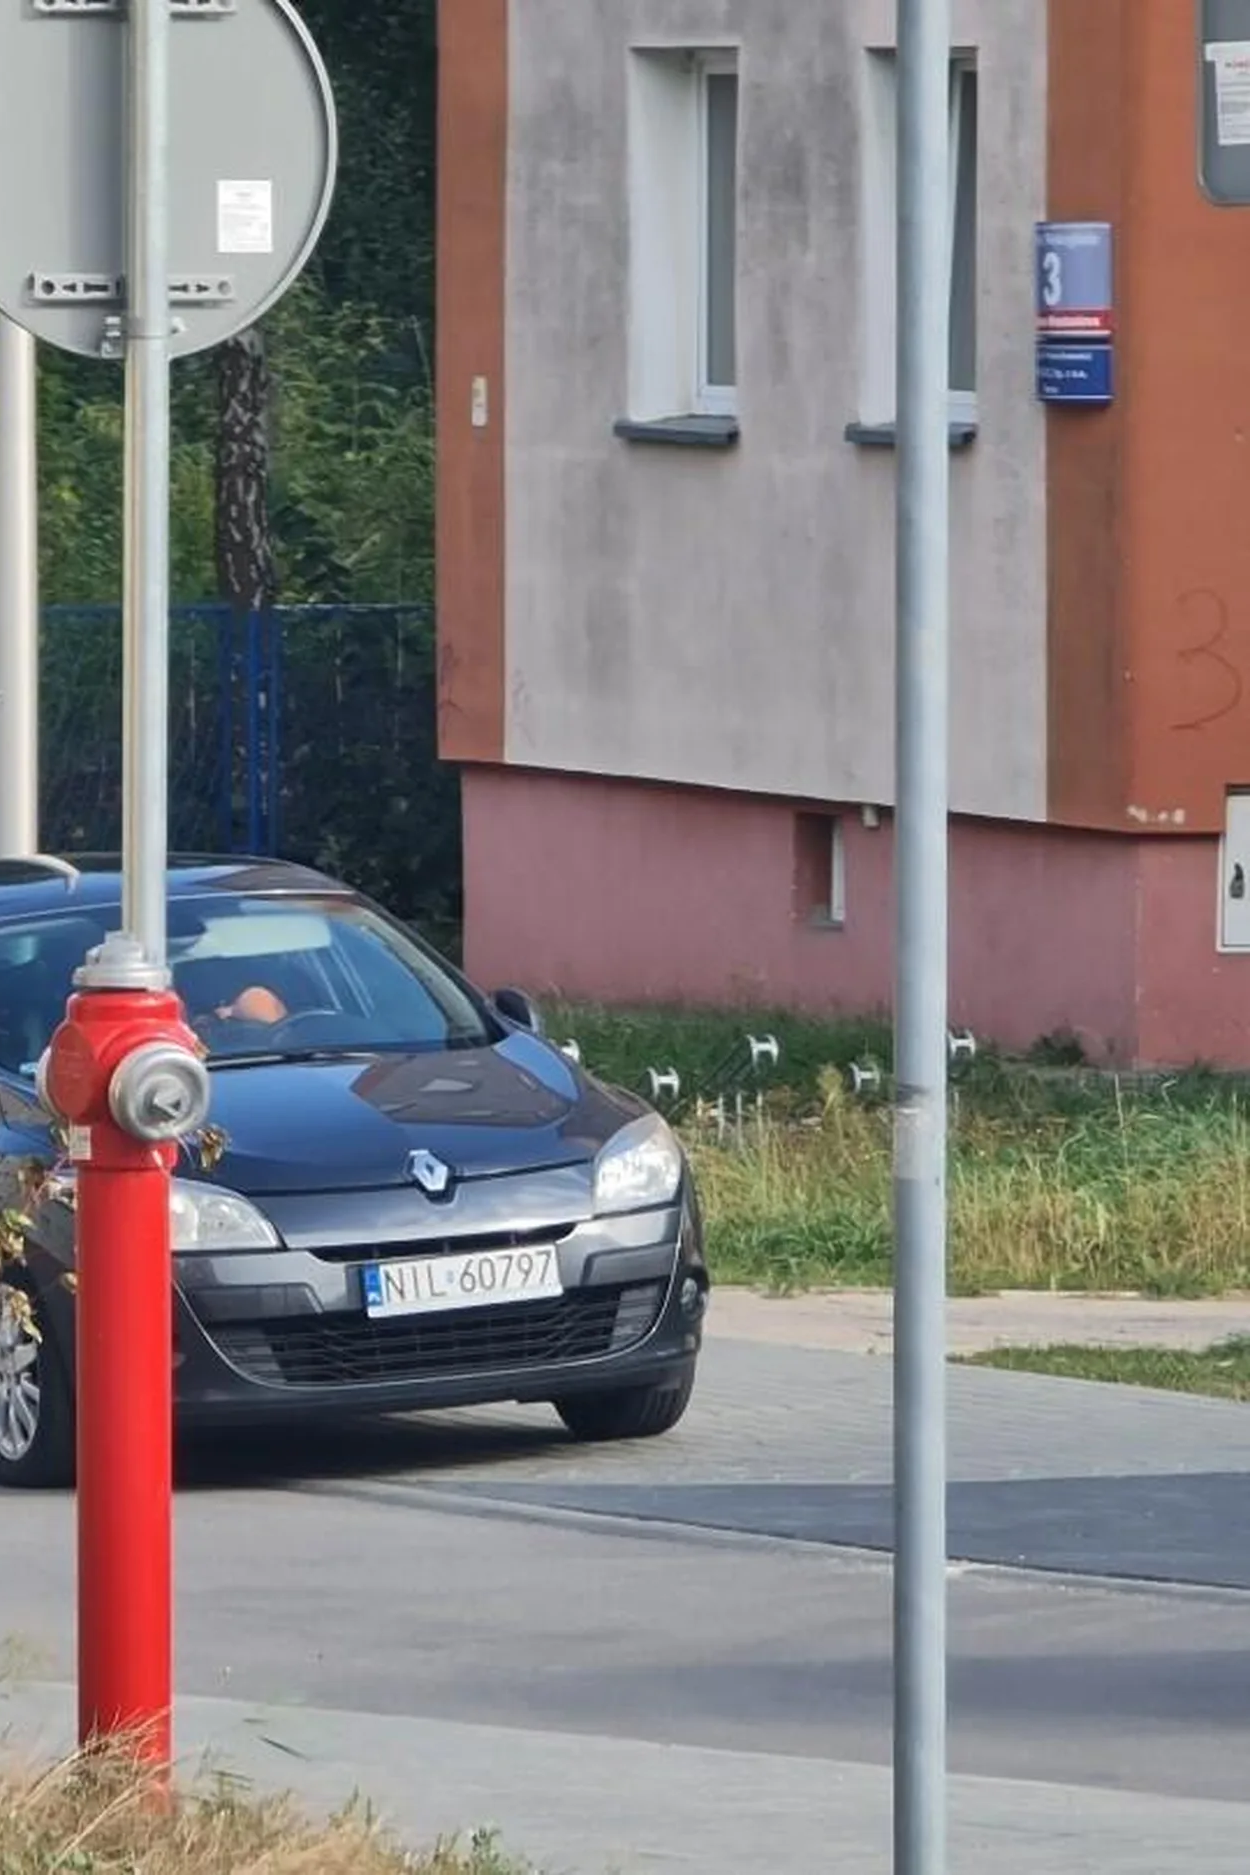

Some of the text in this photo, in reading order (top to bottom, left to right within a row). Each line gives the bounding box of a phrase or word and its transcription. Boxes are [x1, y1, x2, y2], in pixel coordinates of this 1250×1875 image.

[1043, 251, 1062, 306] 3
[384, 1249, 553, 1301] NIL 60797
